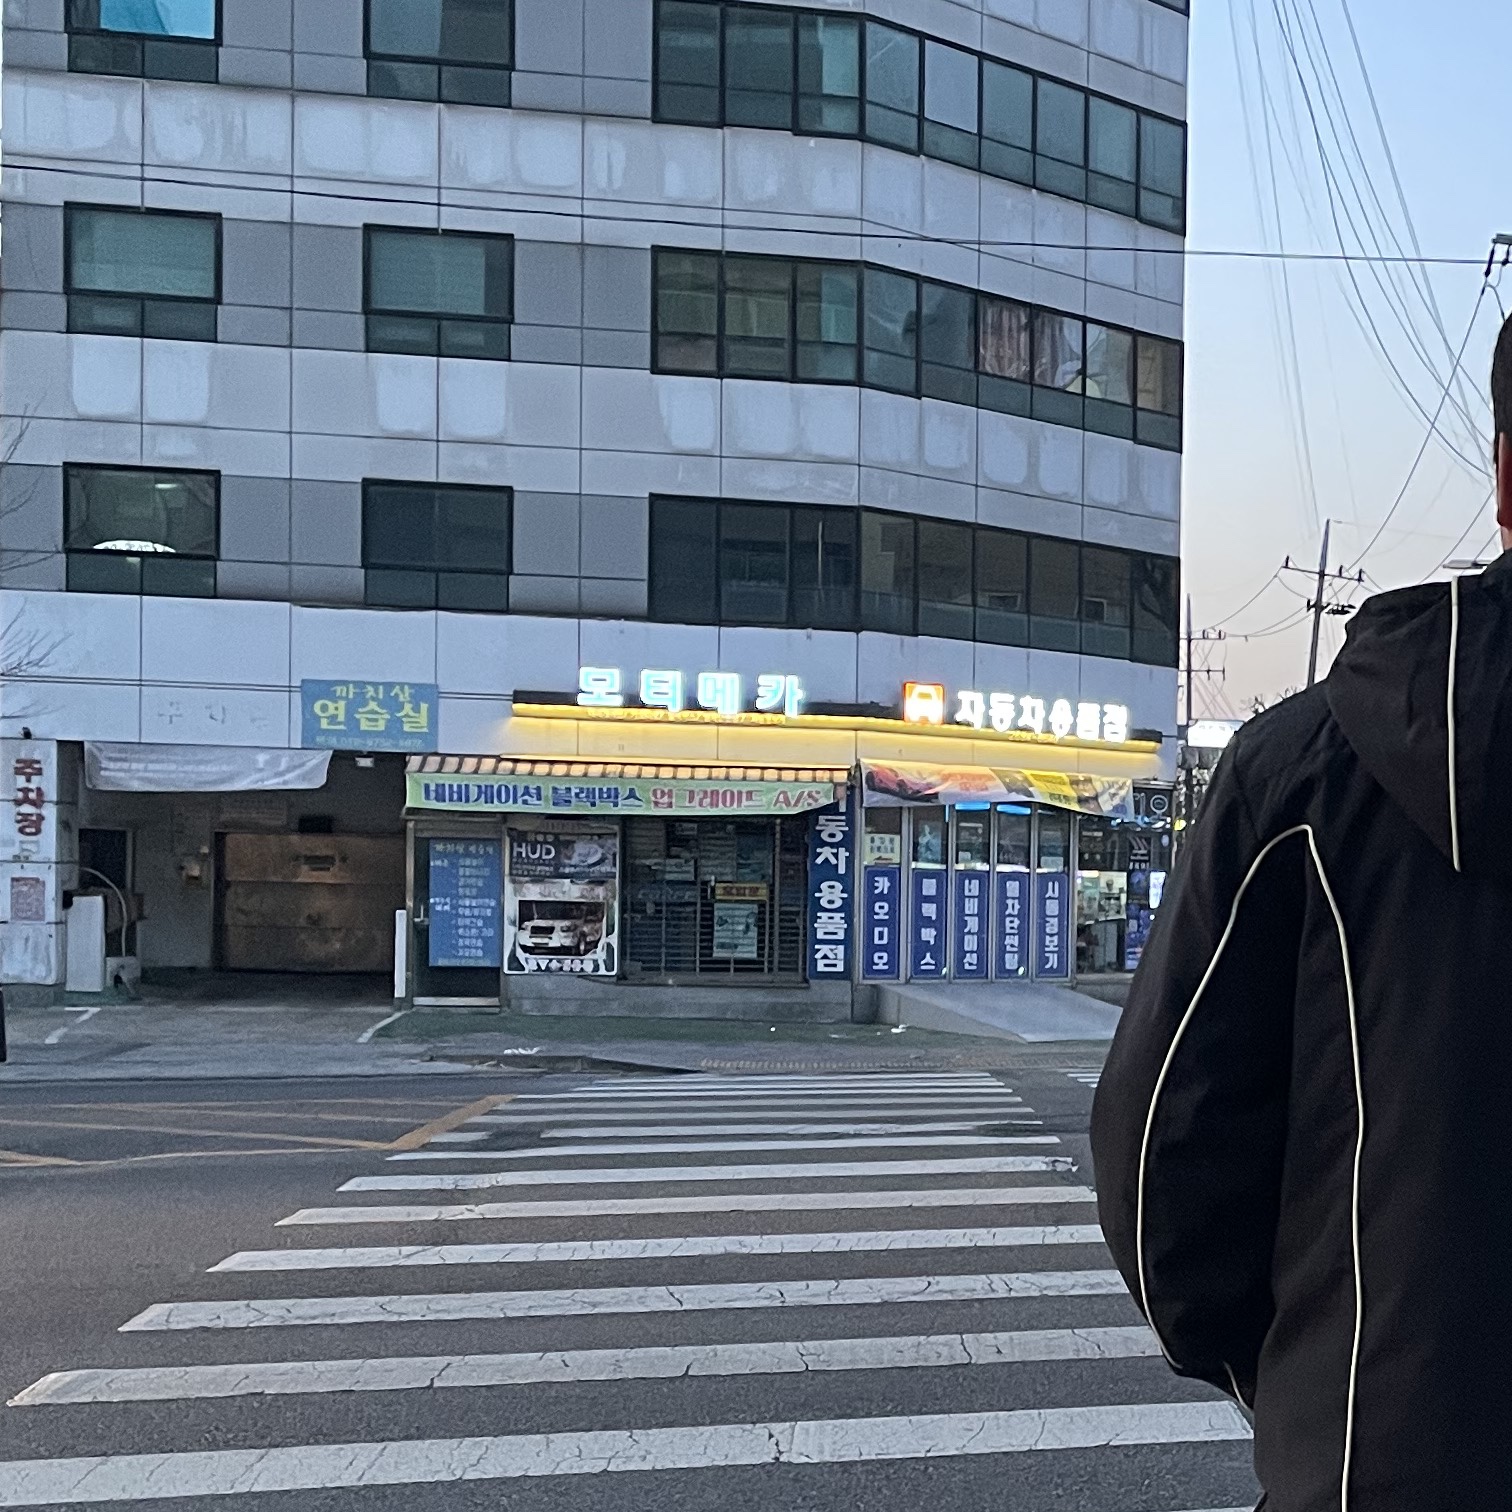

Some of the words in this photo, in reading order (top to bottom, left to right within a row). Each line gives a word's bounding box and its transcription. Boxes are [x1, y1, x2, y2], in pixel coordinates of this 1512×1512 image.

[313, 699, 429, 732] 연습실
[331, 683, 414, 701] 까치산
[576, 667, 805, 718] 모터메카
[954, 690, 1129, 743] 자동차용품점
[14, 759, 45, 836] 주차장
[423, 783, 542, 805] 네비게이션
[552, 786, 644, 808] 블랙박스
[652, 788, 766, 809] 업그레이드
[773, 790, 821, 808] A/S
[512, 842, 556, 860] HUD
[814, 881, 849, 972] 용품점
[872, 876, 891, 970] 카오디오
[920, 878, 937, 970] 블랙박스
